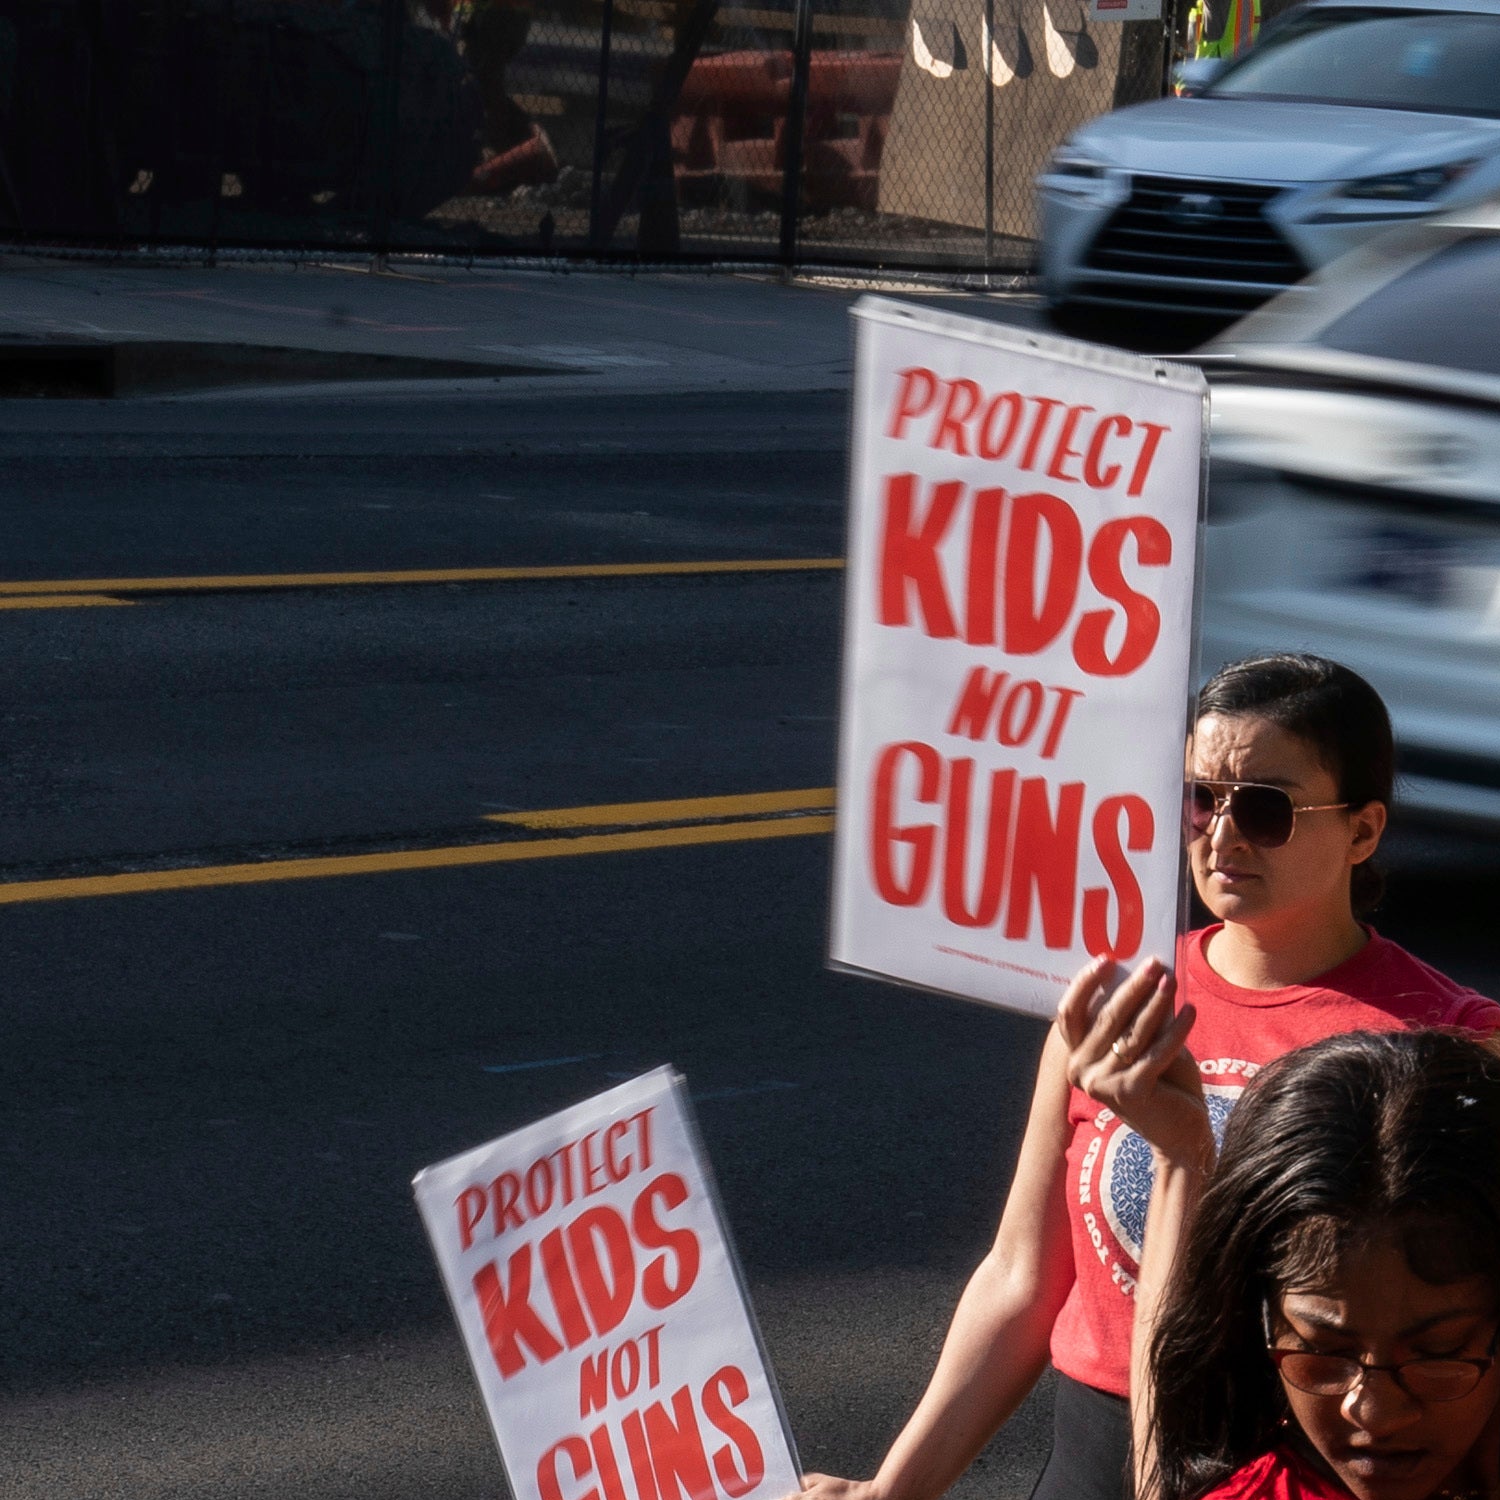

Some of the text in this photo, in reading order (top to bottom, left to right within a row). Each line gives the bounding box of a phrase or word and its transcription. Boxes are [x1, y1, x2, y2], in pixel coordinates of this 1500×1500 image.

[885, 367, 1171, 497] PROTECT
[877, 472, 1172, 678] KIDS
[946, 664, 1086, 760] NOT
[869, 741, 1155, 961] GUNS
[1195, 1057, 1262, 1078] OFFE
[453, 1105, 658, 1253] PROTECT
[1079, 1137, 1102, 1205] NEED
[472, 1172, 701, 1381] KIDS
[1084, 1212, 1110, 1265] YOU
[580, 1323, 667, 1420] NOT
